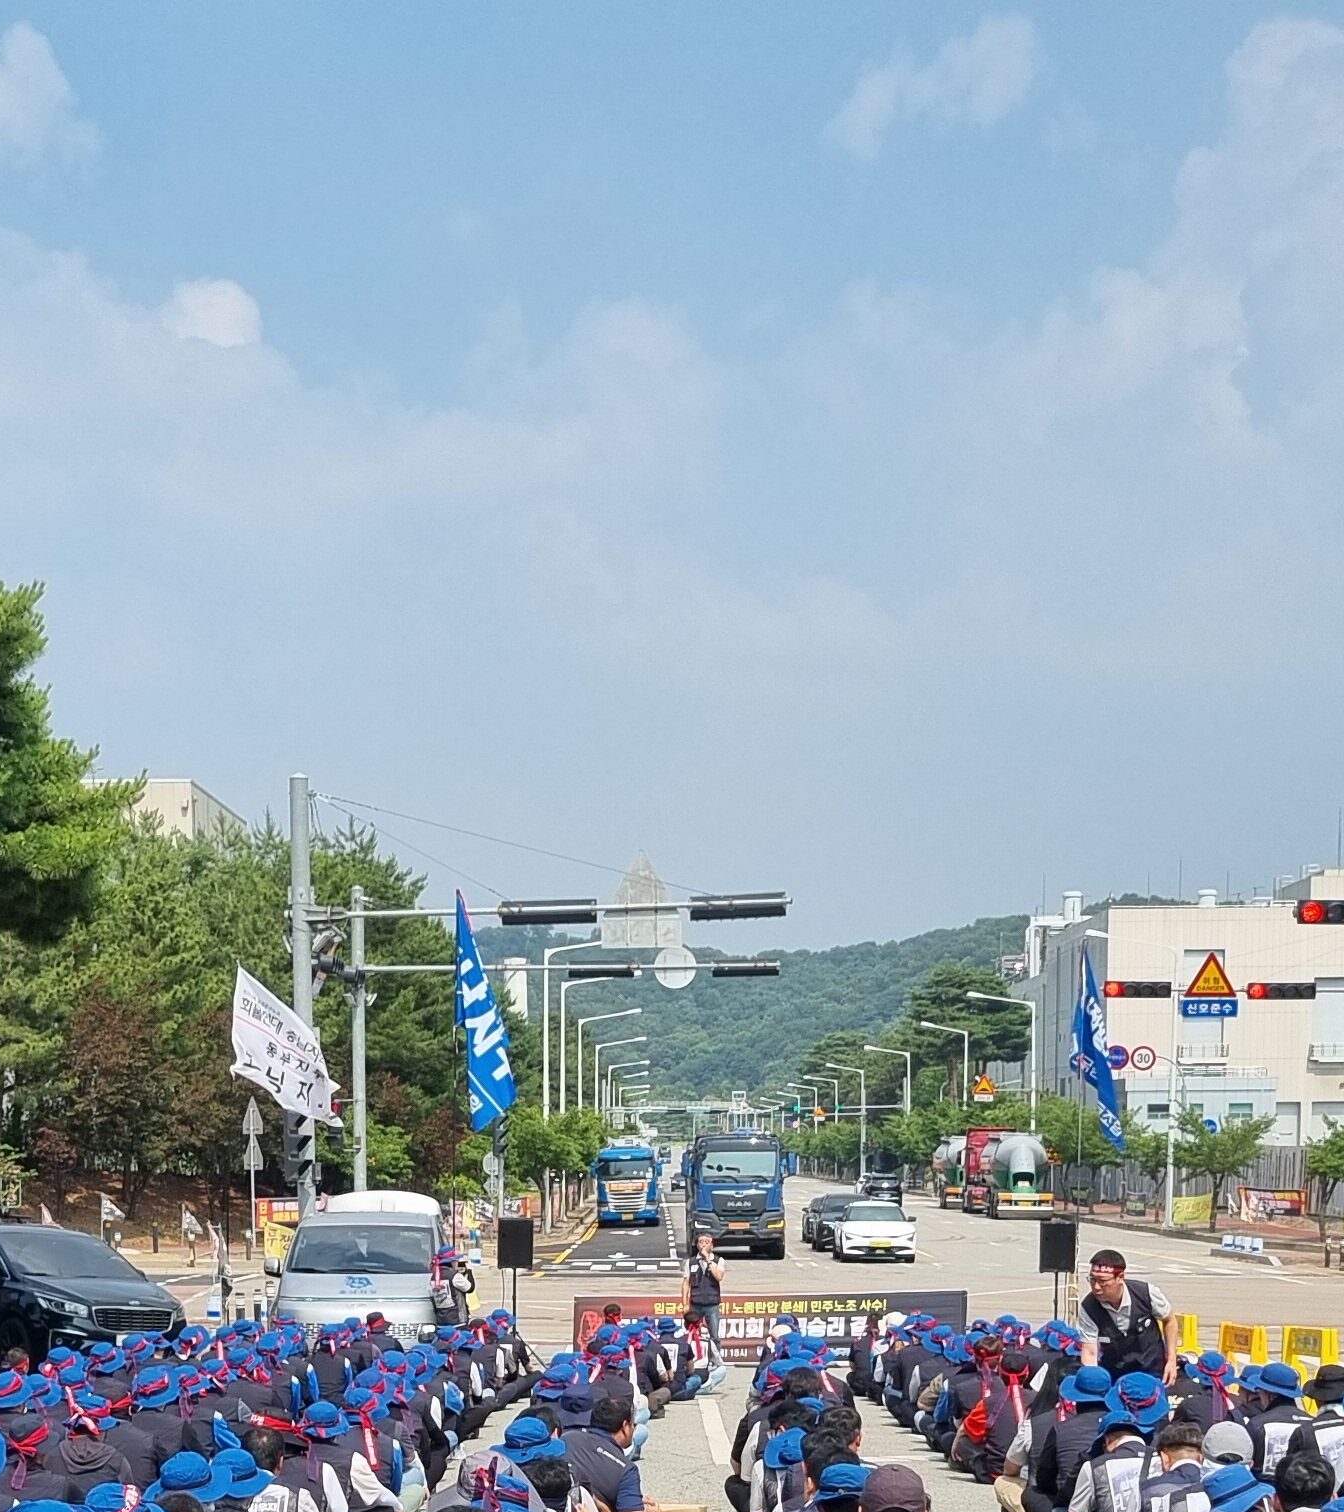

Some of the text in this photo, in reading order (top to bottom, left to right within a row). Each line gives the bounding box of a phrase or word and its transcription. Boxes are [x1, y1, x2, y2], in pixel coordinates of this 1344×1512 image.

[1187, 1002, 1233, 1015] 신호준수
[1137, 1053, 1150, 1064] 30
[811, 1300, 857, 1312] 민주노조
[860, 1299, 887, 1311] 사수!
